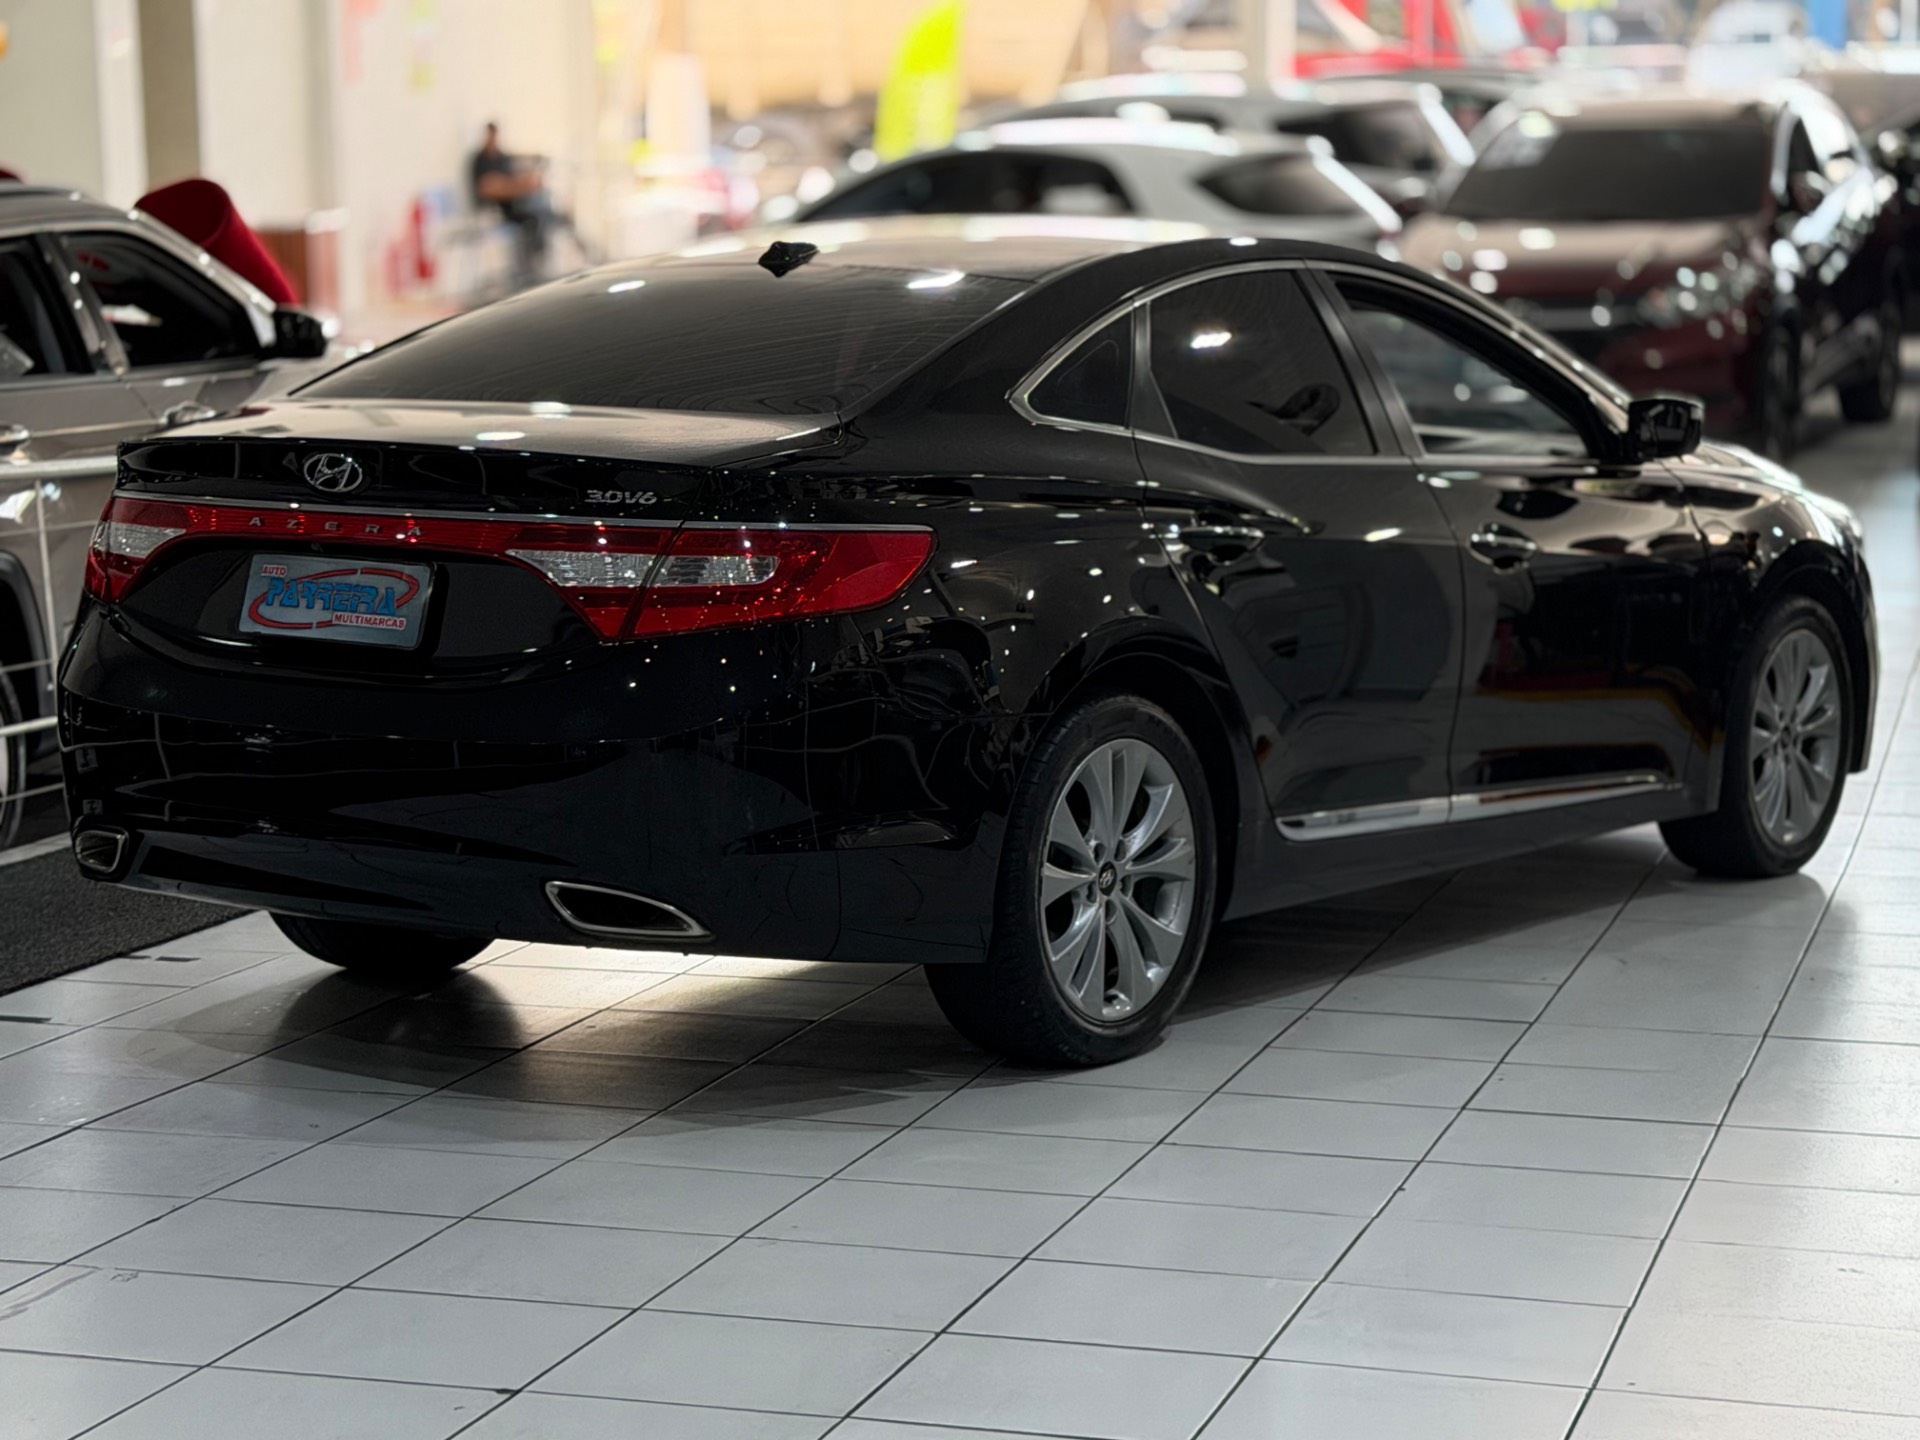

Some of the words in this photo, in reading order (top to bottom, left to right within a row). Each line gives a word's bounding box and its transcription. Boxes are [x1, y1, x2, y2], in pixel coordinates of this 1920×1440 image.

[249, 516, 421, 536] AZERA
[262, 566, 287, 576] AUTO
[334, 613, 405, 628] MULTIMARCAS
